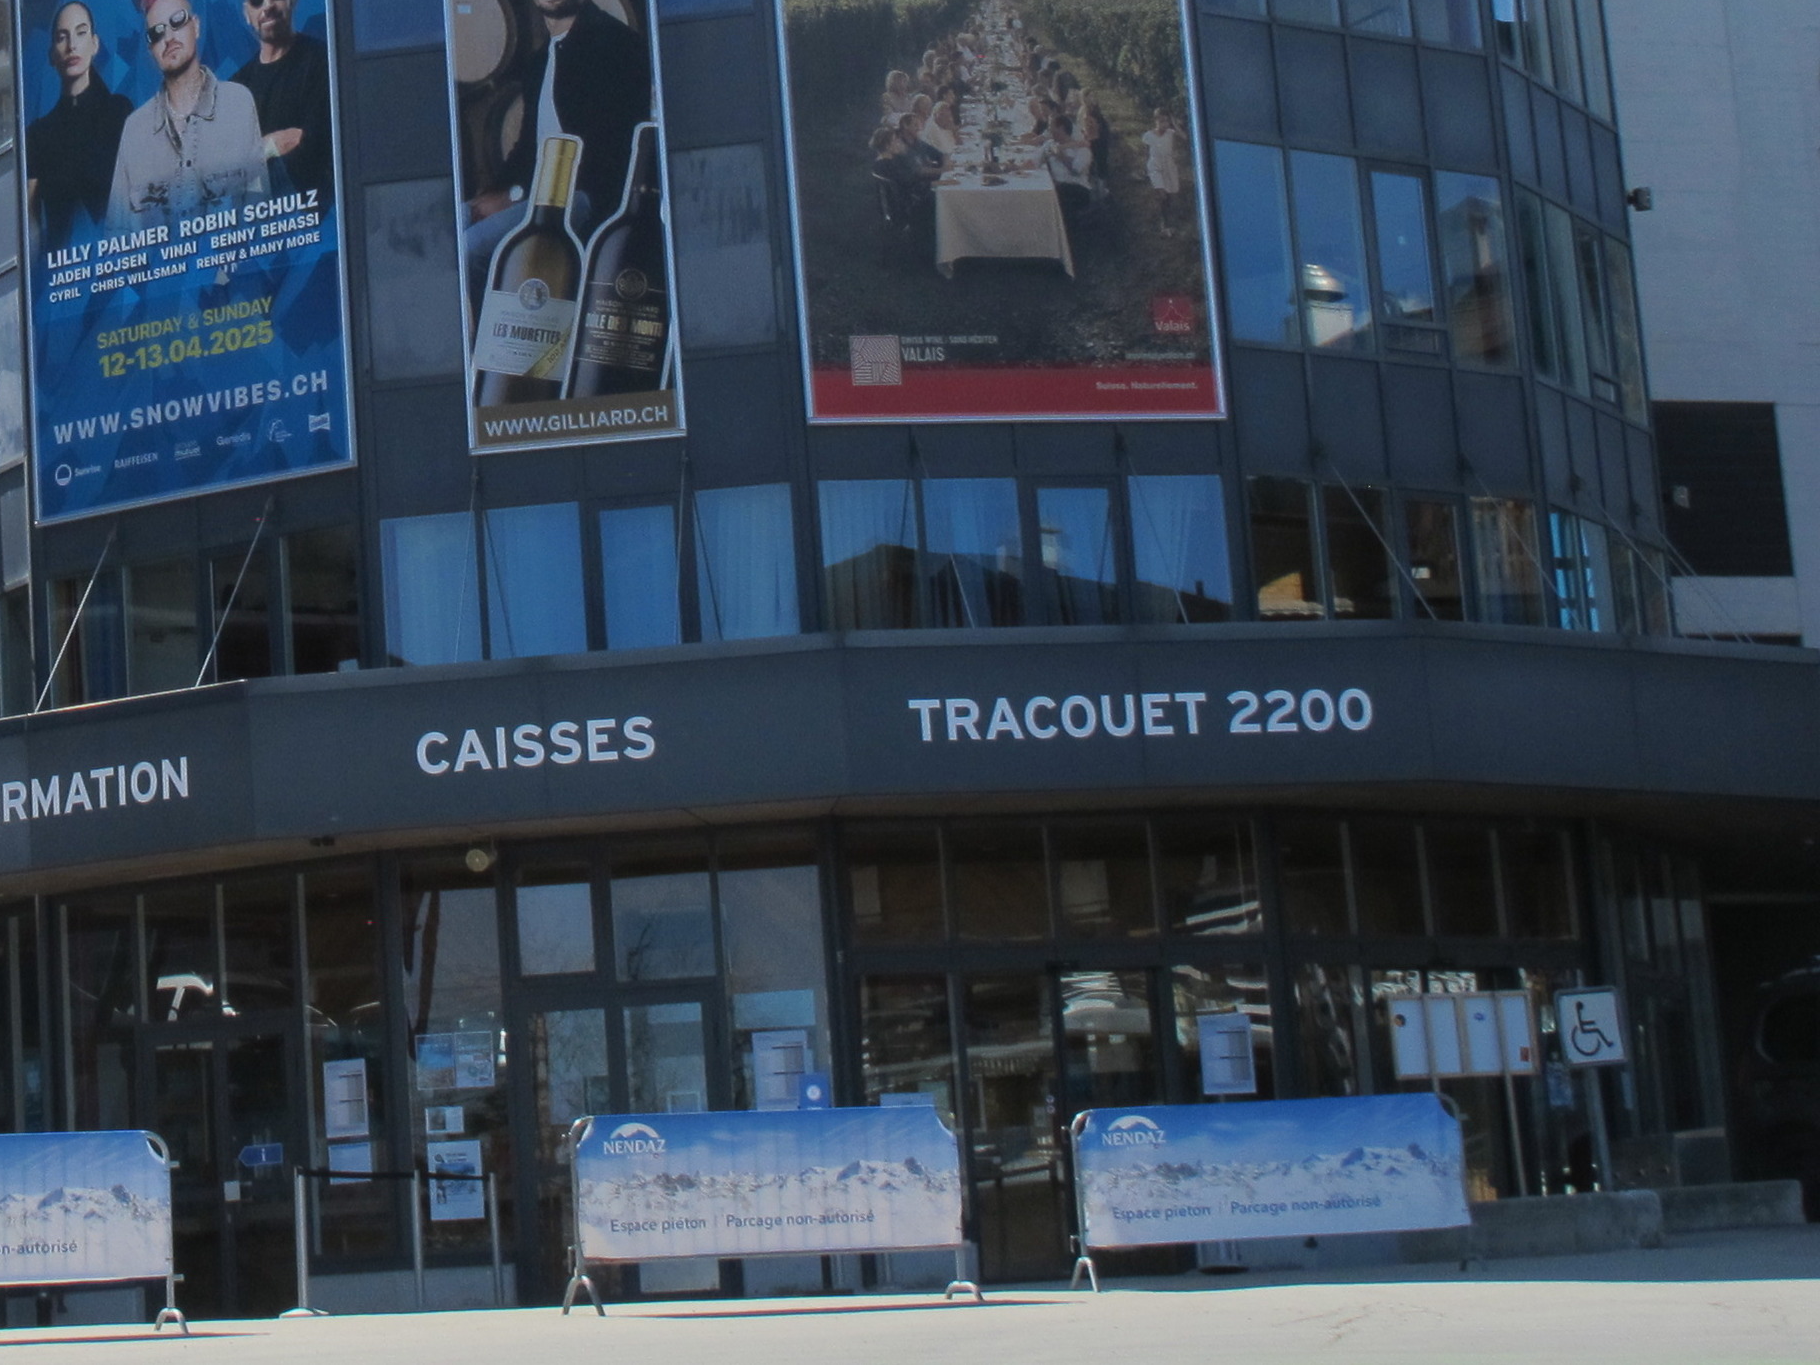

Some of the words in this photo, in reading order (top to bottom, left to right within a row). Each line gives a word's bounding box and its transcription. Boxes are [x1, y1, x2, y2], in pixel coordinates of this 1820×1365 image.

[47, 244, 91, 269] LILLY
[97, 225, 169, 257] PALMER
[180, 209, 237, 238] ROBIN
[243, 189, 319, 223] SCHULZ
[49, 266, 91, 287] JADEN
[95, 252, 148, 276] BOJSEN
[160, 241, 198, 260] VINAI
[210, 228, 256, 249] BENNY
[260, 212, 320, 238] BENASSI
[49, 287, 81, 303] CYRIL
[90, 277, 125, 294] CHRIS
[127, 262, 187, 286] WILLSMAN
[196, 253, 237, 271] RENEW
[239, 248, 247, 259] &
[250, 240, 284, 258] MANY
[286, 231, 321, 250] MORE
[97, 316, 182, 350] SATURDAY
[188, 313, 199, 330] &
[202, 296, 273, 327] SUNDAY
[1155, 321, 1191, 332] Valais
[98, 321, 274, 378] 12-13.04.2025
[901, 346, 945, 361] VALAIS
[53, 369, 328, 445] WWW.SNOWVIBES.CH
[485, 406, 668, 436] WWW.GILLIARD.CH
[114, 451, 159, 469] RAIFFEISEN
[908, 691, 1207, 742] TRACOUET
[1226, 687, 1374, 734] 2200
[416, 715, 657, 775] CAISSES
[603, 1139, 666, 1155] NENDAZ
[1101, 1130, 1166, 1146] NENDAZ
[610, 1218, 657, 1234] Espace
[661, 1214, 707, 1233] piéton
[726, 1213, 782, 1229] Parcage
[786, 1209, 875, 1225] non-autorisé
[1113, 1206, 1160, 1223] Espace
[1231, 1199, 1287, 1217] Parcage
